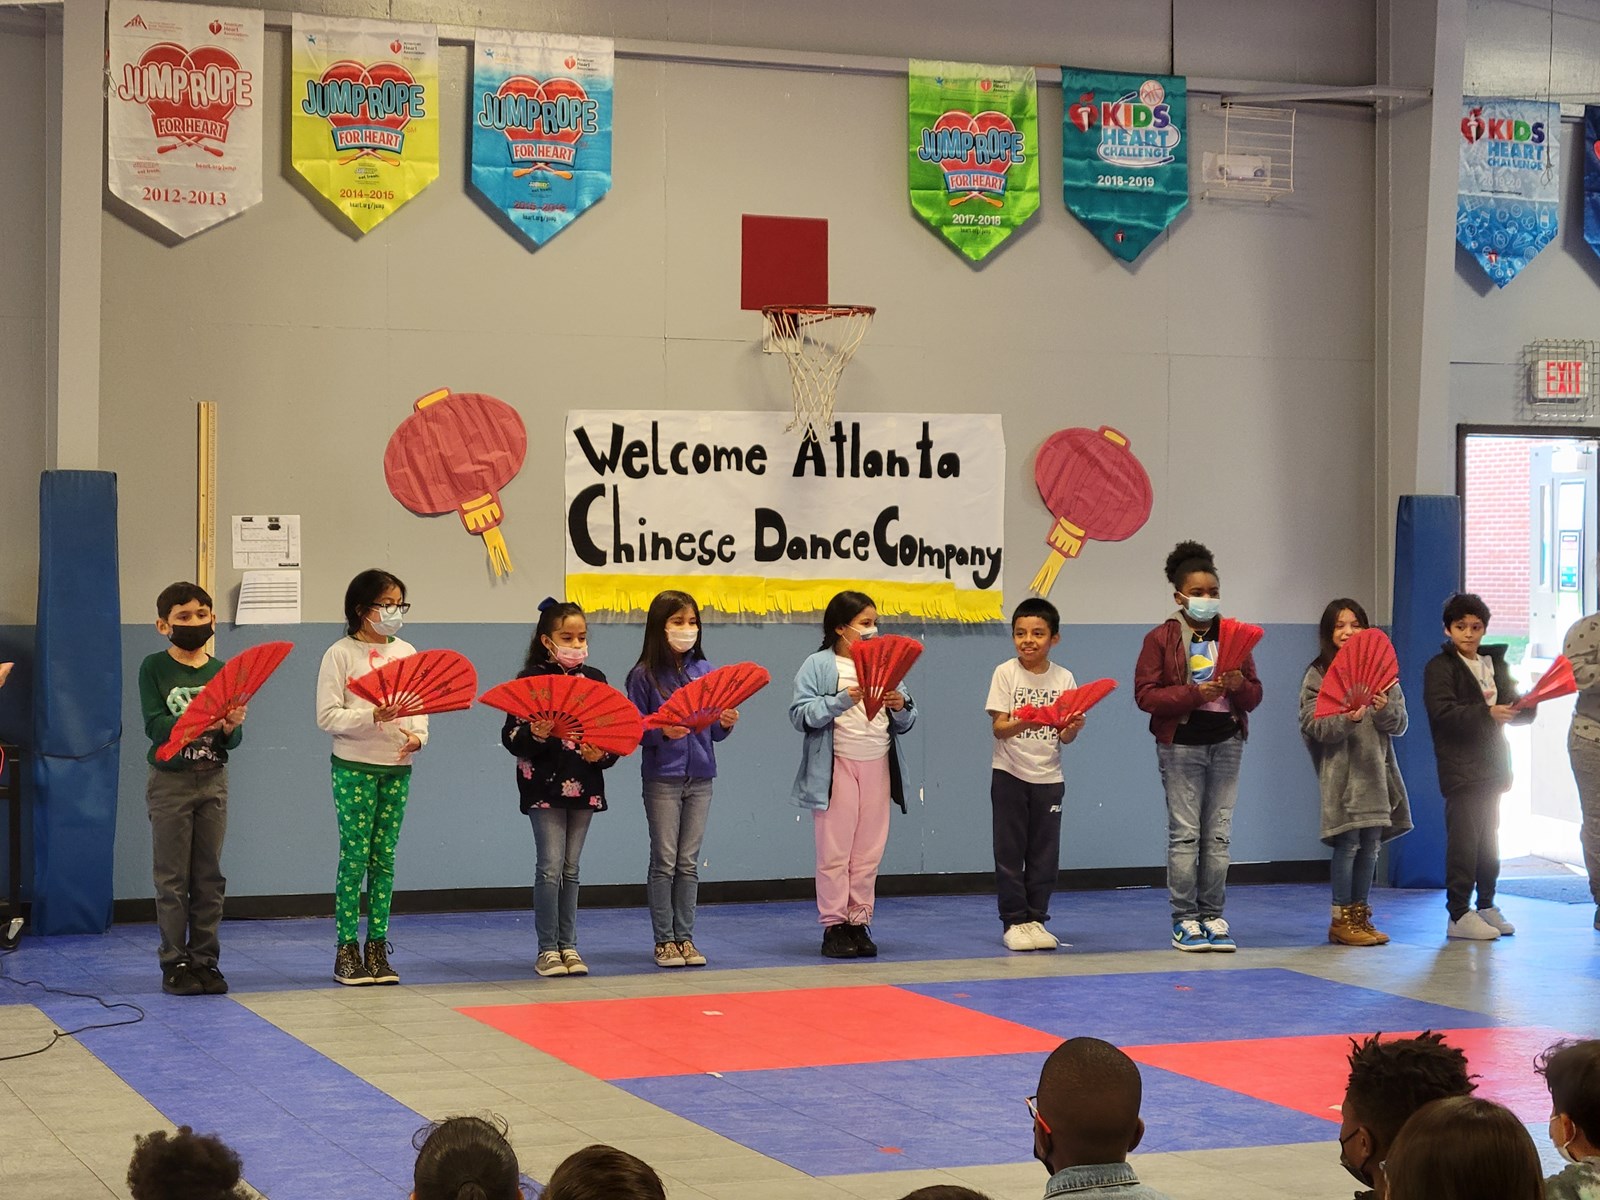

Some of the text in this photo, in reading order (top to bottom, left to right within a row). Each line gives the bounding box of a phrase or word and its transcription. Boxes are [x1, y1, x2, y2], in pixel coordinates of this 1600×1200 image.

[117, 62, 253, 108] JUMP ROPE
[302, 79, 426, 120] JUMP ROPE
[479, 92, 599, 135] JUMP ROPE
[1102, 101, 1171, 129] KIDS
[157, 117, 226, 138] FOR HEART
[1102, 127, 1170, 148] HEART
[1487, 118, 1545, 144] KIDS
[338, 129, 401, 148] FOR HEART
[918, 127, 1026, 165] JUMP ROPE
[513, 143, 576, 162] FOR HEART
[1102, 146, 1169, 158] CHALLENGE
[1487, 142, 1545, 161] HEART
[1487, 157, 1544, 171] CHALLENGE
[949, 174, 1005, 191] FOR HEART
[1097, 175, 1155, 188] 2018-2019
[142, 186, 227, 206] 2012-2013
[339, 188, 395, 200] 2014-2015
[952, 213, 1002, 226] 2017-2018
[1546, 361, 1583, 396] EXIT
[573, 420, 961, 479] Welcome Atlanta
[568, 483, 1003, 590] Chinese Dance Company
